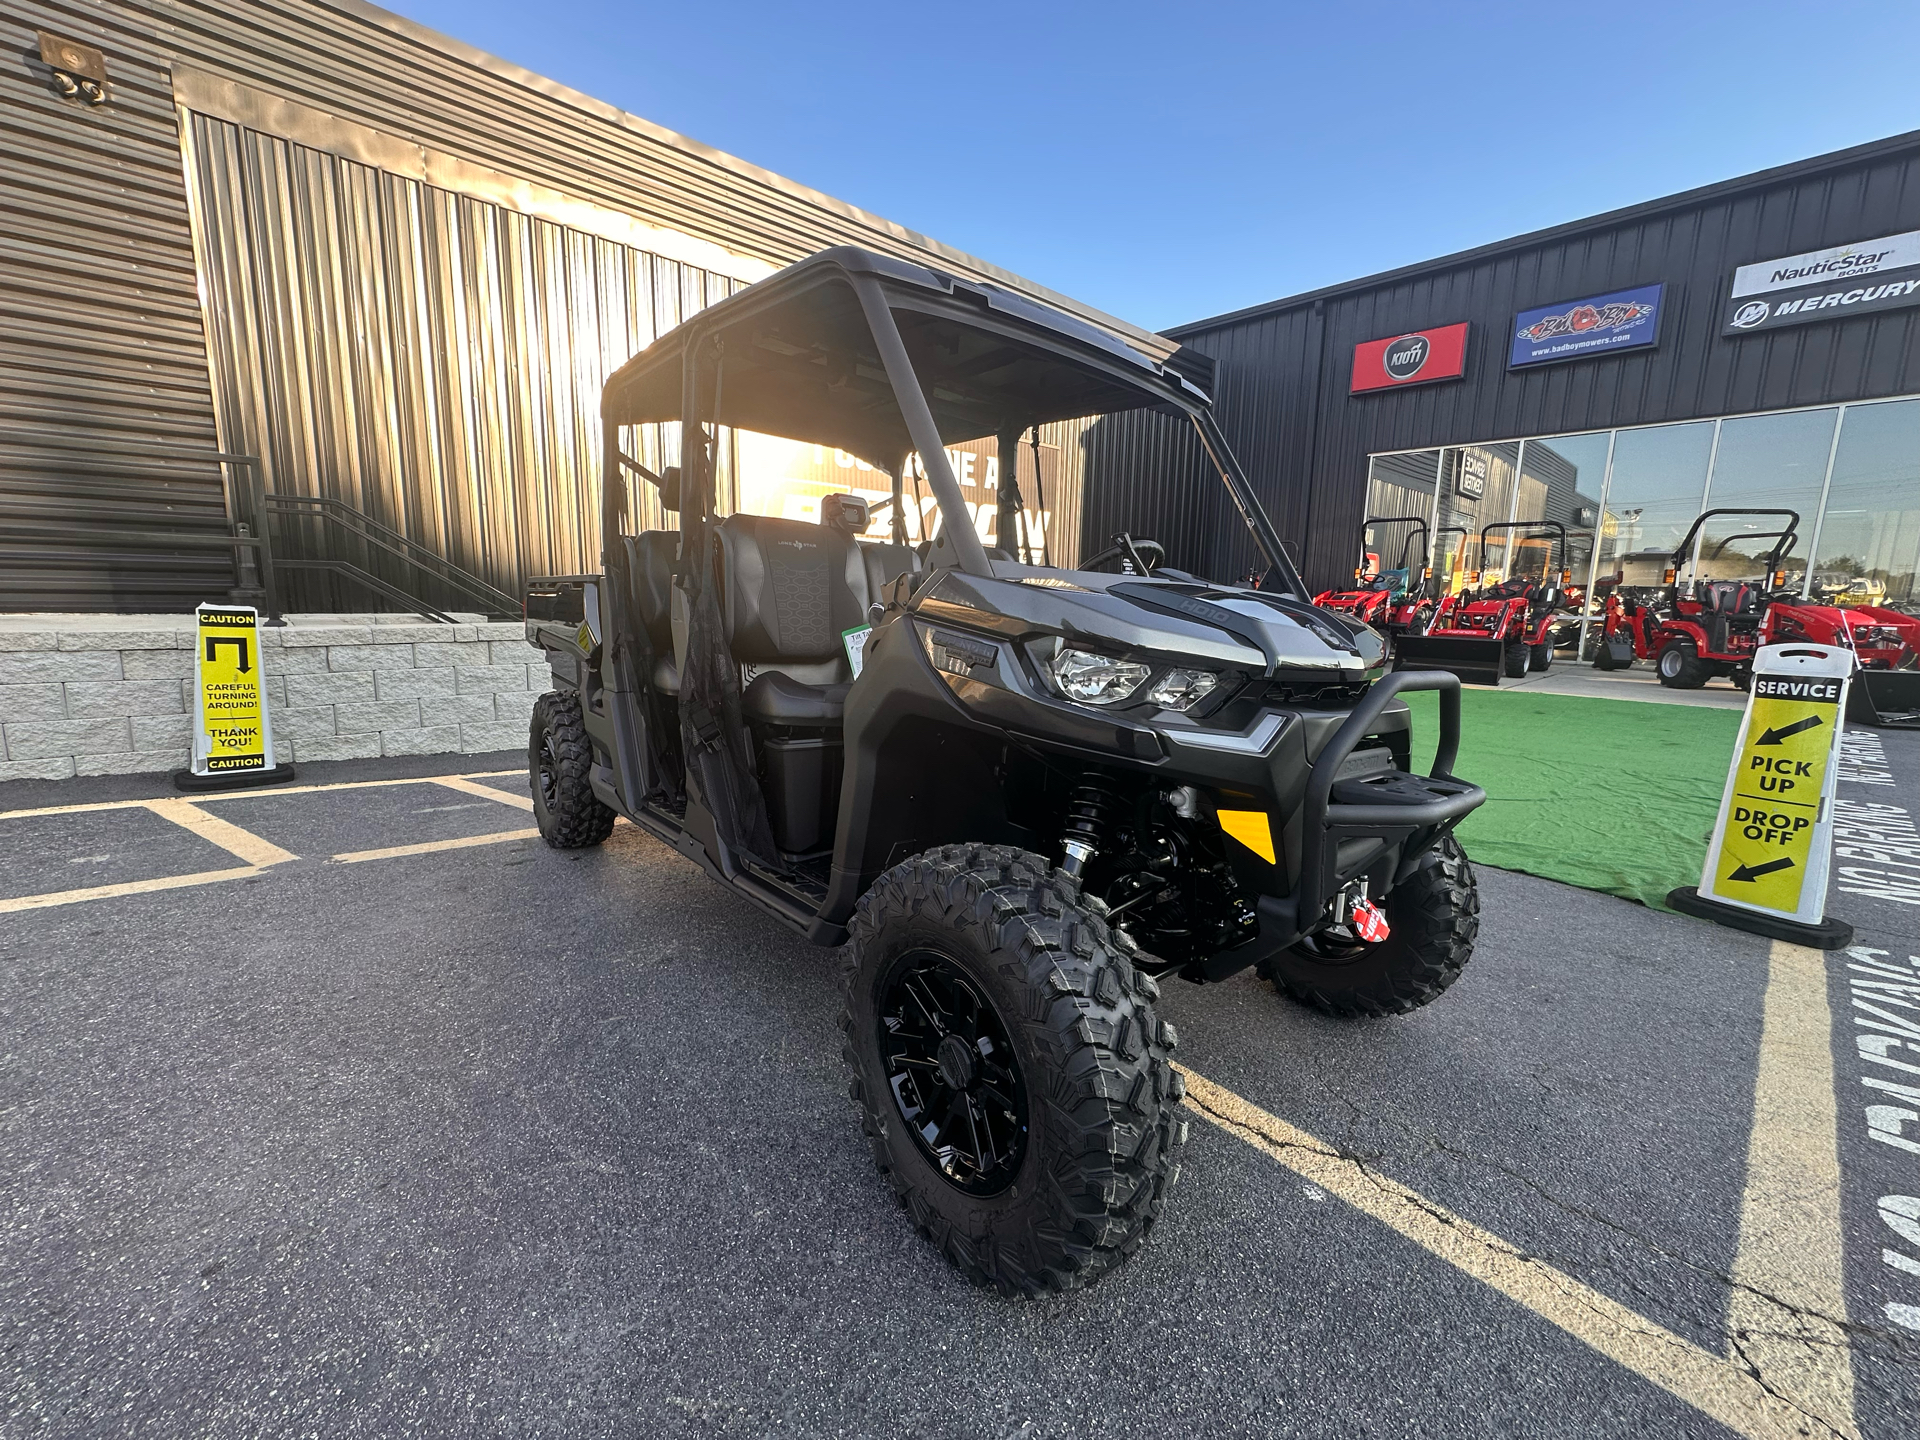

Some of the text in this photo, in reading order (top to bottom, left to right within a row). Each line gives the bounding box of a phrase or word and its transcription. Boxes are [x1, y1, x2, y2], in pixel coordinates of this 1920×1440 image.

[1770, 251, 1889, 283] NauticStar
[1837, 265, 1879, 277] BOATS
[1773, 280, 1920, 316] MERCURY
[1531, 333, 1630, 356] www.badboymowers.com
[200, 614, 255, 624] CAUTION
[1180, 600, 1229, 622] HD10
[1787, 610, 1815, 622] mahindra
[206, 683, 256, 691] CAREFUL
[1757, 680, 1837, 699] SERVICE
[207, 692, 256, 700] TURNING
[207, 701, 258, 709] AROUND!
[209, 727, 258, 737] THANK
[218, 738, 252, 747] YOU!
[209, 757, 262, 768] CAUTION
[1750, 756, 1813, 777] PICK
[1759, 776, 1795, 793] UP
[1734, 806, 1810, 831] DROP
[1743, 825, 1794, 845] OFF
[1832, 799, 1920, 869] PARKING
